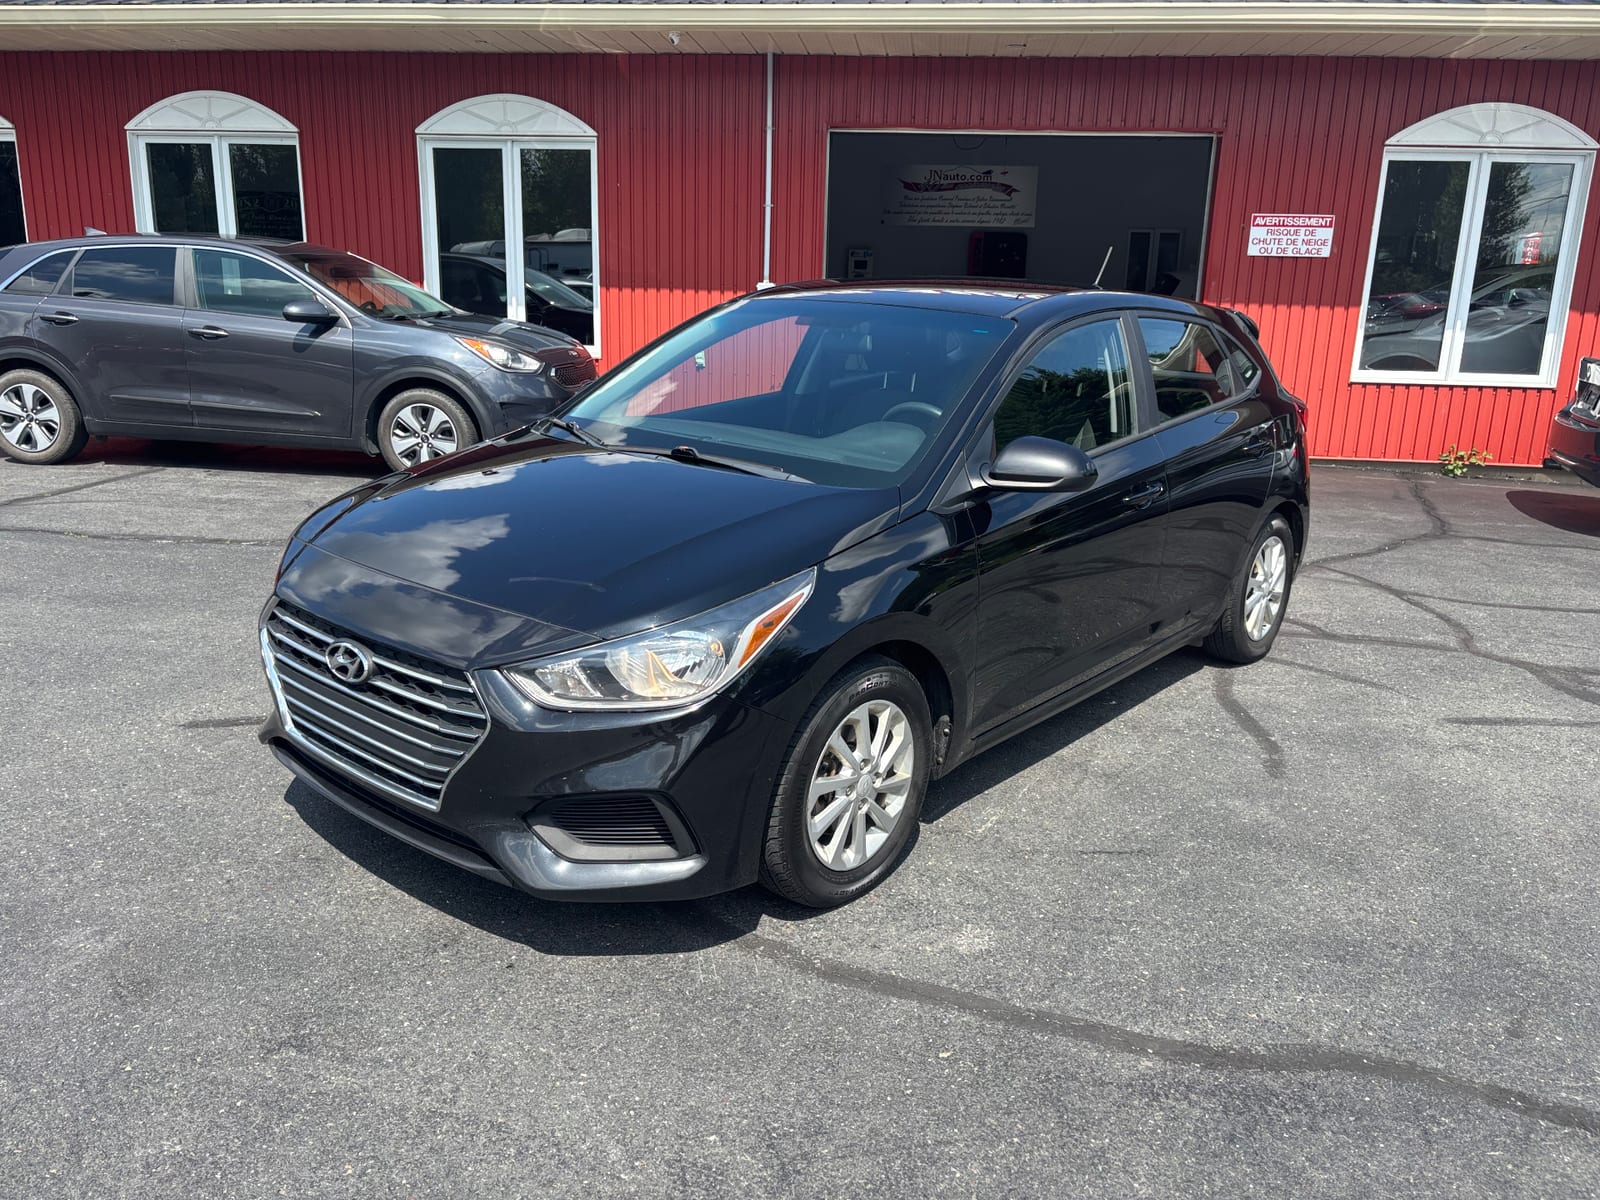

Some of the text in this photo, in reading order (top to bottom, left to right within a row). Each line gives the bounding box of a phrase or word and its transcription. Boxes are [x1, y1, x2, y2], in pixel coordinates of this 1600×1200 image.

[924, 169, 992, 181] JNauto.com
[1253, 216, 1332, 226] AVERTISSEMENT
[1266, 228, 1317, 237] RISQUE DE
[1251, 237, 1329, 247] CHUTE DE NEIGE
[1258, 246, 1323, 256] OU DE GLACE
